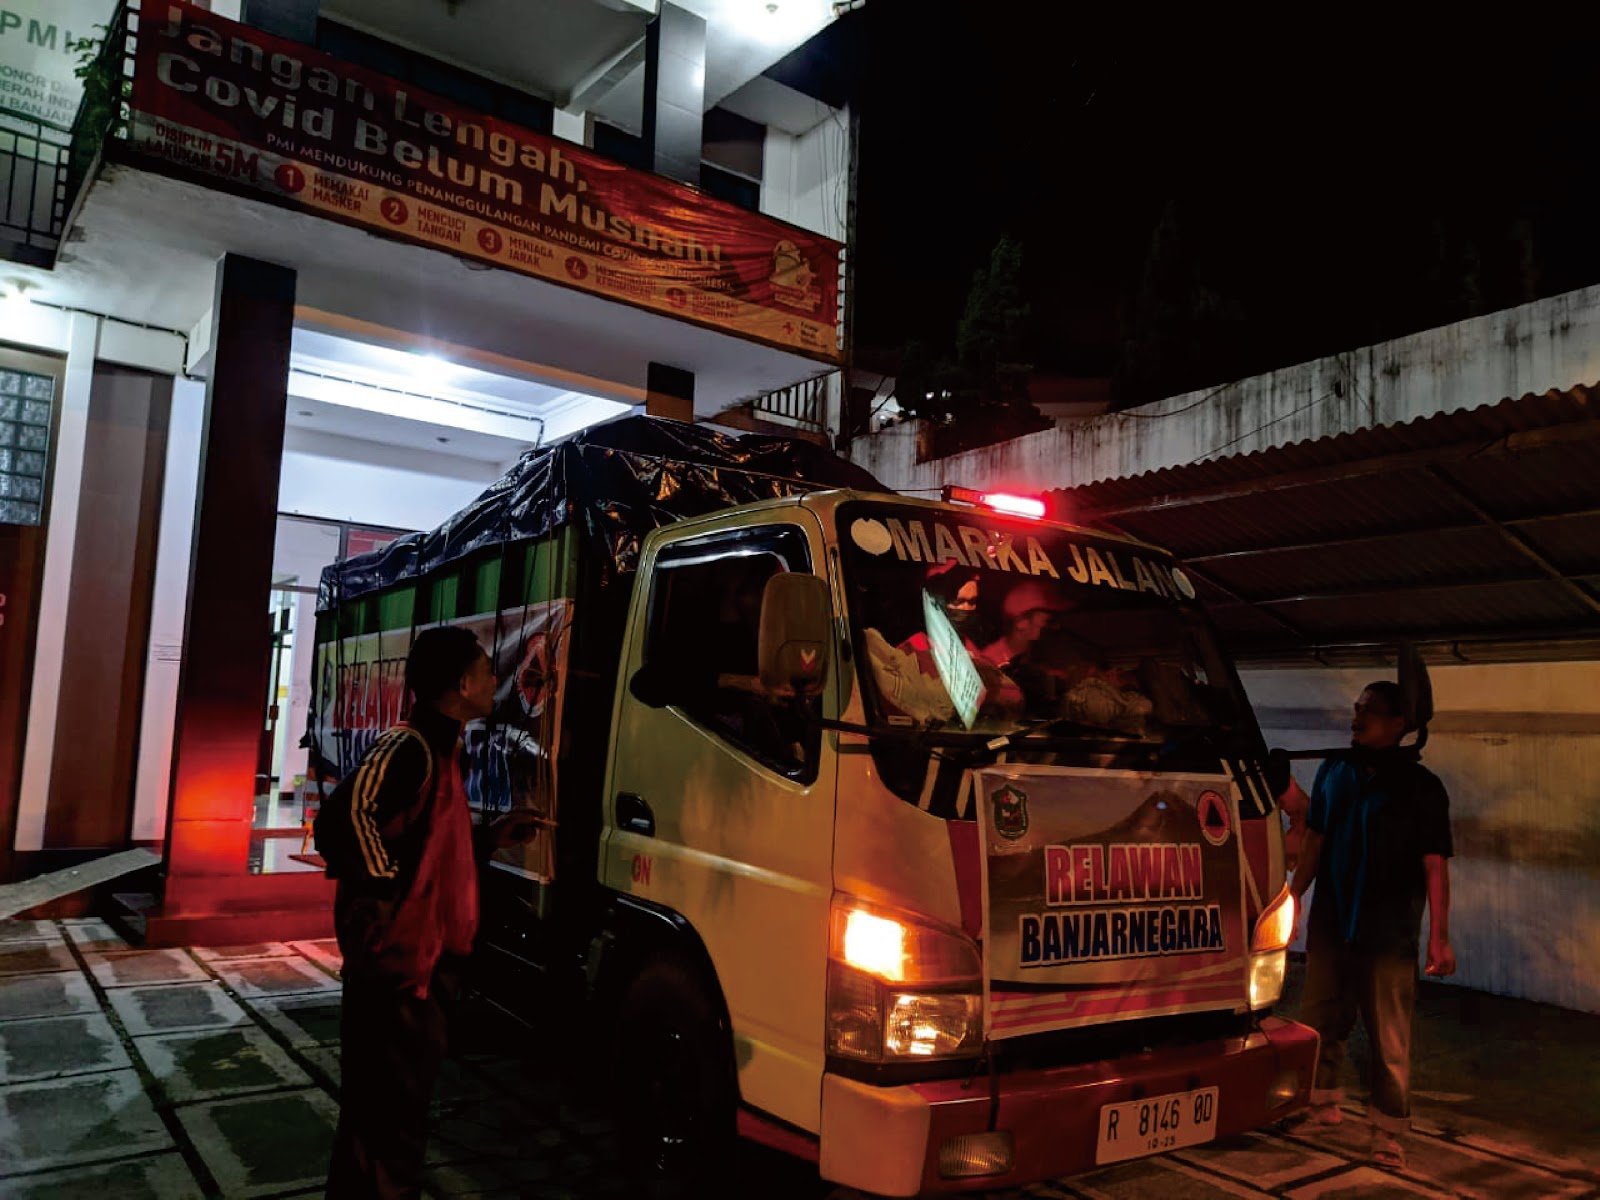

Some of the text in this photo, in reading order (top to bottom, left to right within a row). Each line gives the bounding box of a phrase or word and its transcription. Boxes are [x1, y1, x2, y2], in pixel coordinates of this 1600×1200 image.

[0, 10, 72, 54] PMI
[159, 5, 588, 192] Jangan Lengah,
[157, 51, 721, 271] Covid Belum Musnah!
[214, 143, 259, 182] 5M
[266, 132, 295, 151] PMI
[300, 147, 402, 186] MENDUKUNG
[406, 180, 541, 232] PENANGGULANGAN
[543, 224, 600, 251] PANDEMI
[312, 188, 362, 213] MASKER
[313, 173, 369, 201] MEMAKAI
[416, 219, 462, 244] TANGAN
[417, 206, 466, 232] MENCUCI
[885, 517, 1061, 580] MARKA
[1066, 542, 1182, 601] JALAN
[1044, 842, 1203, 906] RELAWAN
[1019, 904, 1226, 968] BANJARNEGARA
[1107, 1109, 1119, 1141] R
[1139, 1099, 1181, 1136] 8146
